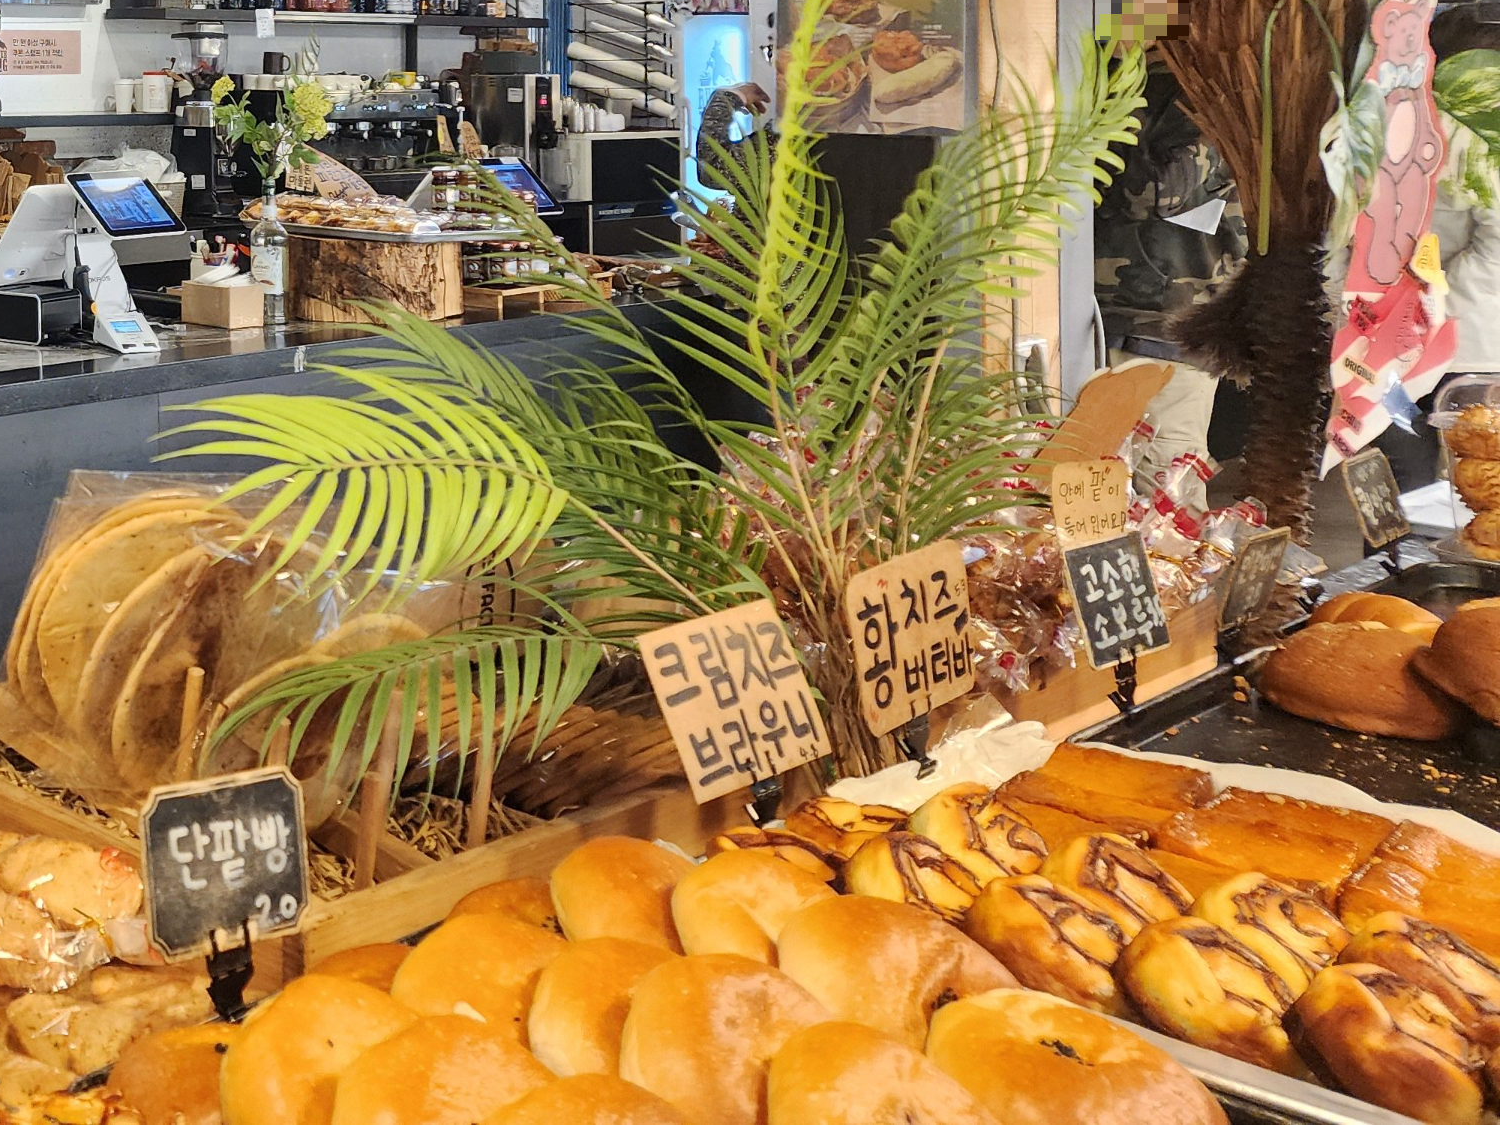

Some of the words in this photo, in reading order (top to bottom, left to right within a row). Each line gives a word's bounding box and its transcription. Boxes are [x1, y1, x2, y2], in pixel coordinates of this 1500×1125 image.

[1059, 482, 1085, 505] 안에
[1080, 548, 1146, 603] 고소한
[654, 622, 799, 709] 크림치즈
[904, 632, 973, 694] 버터바
[689, 691, 820, 787] 브라우니
[168, 814, 290, 890] 단팥빵
[255, 893, 297, 921] 2.0
